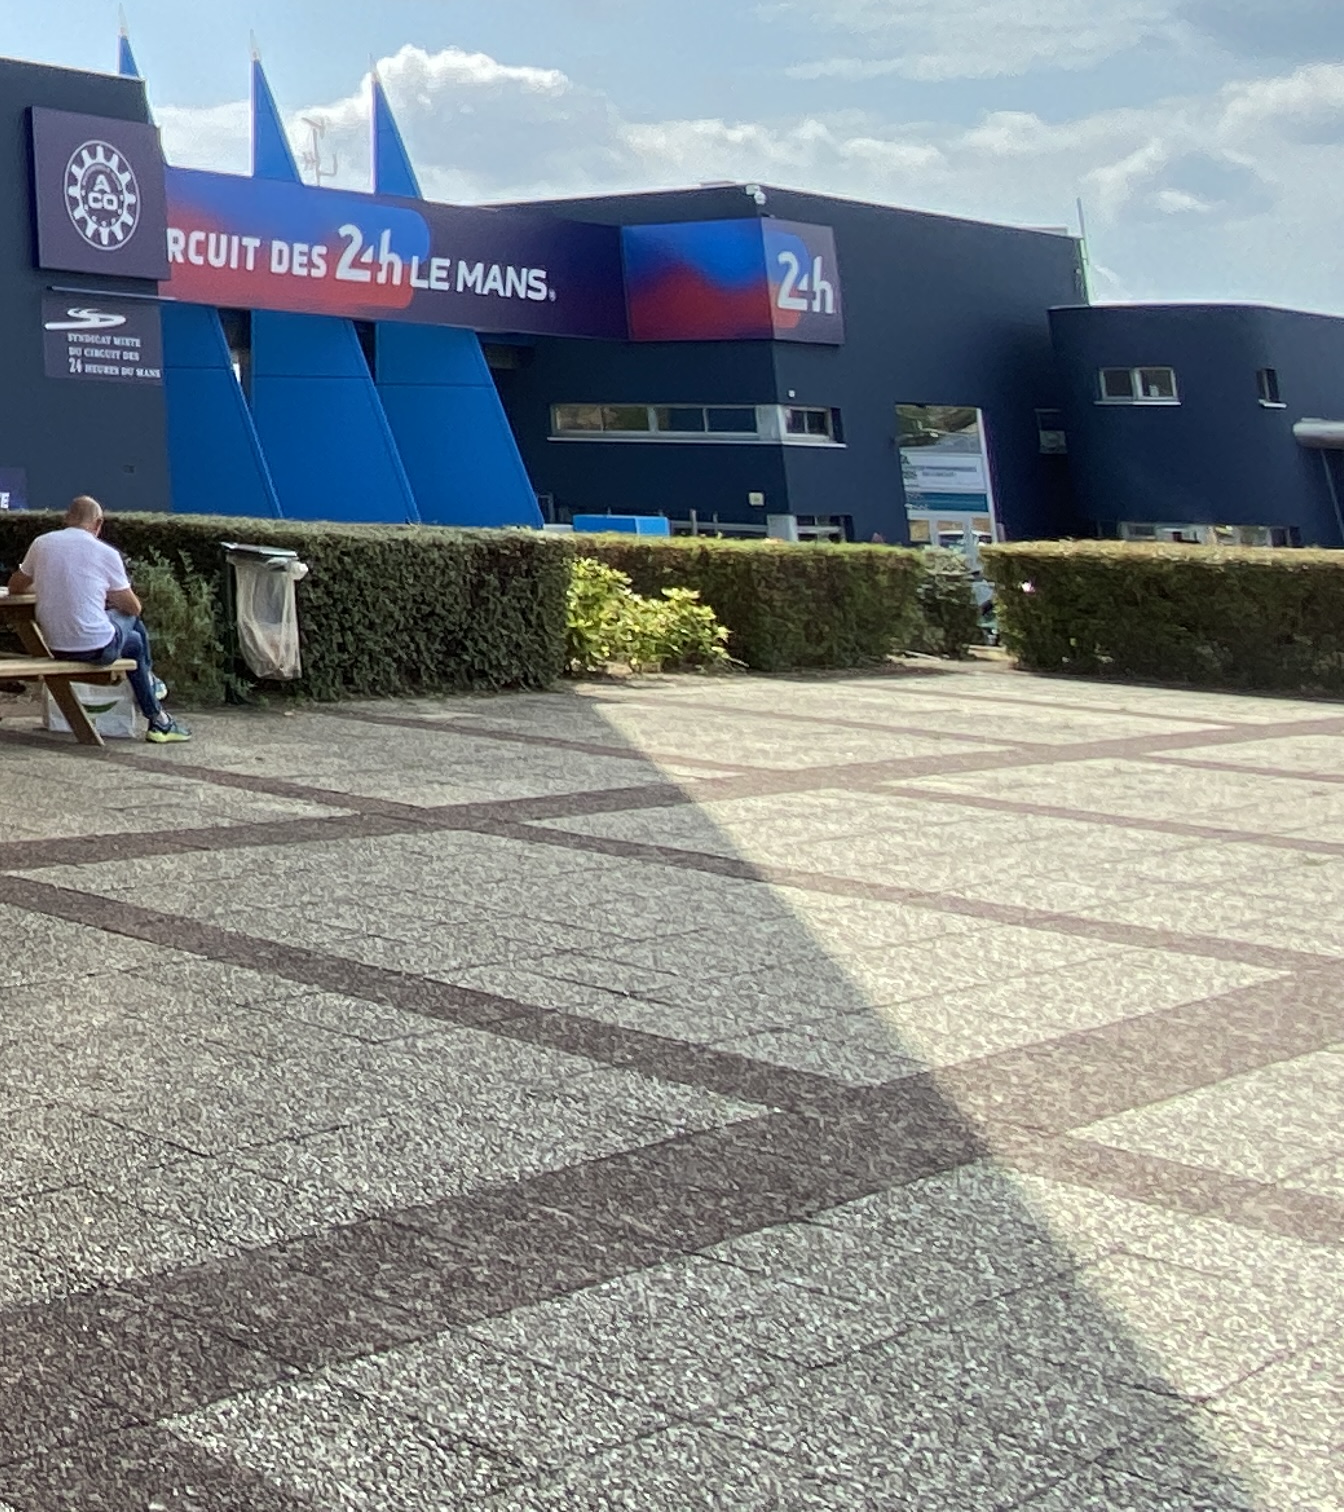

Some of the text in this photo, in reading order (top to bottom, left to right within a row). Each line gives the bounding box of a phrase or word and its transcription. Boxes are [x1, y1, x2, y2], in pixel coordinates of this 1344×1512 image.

[270, 240, 328, 277] DES
[336, 223, 401, 286] 24h
[410, 255, 451, 291] LE
[778, 251, 834, 315] 24h
[68, 347, 140, 361] DU CIRCUIT DES
[68, 357, 161, 378] 24 HEURES DU MANS
